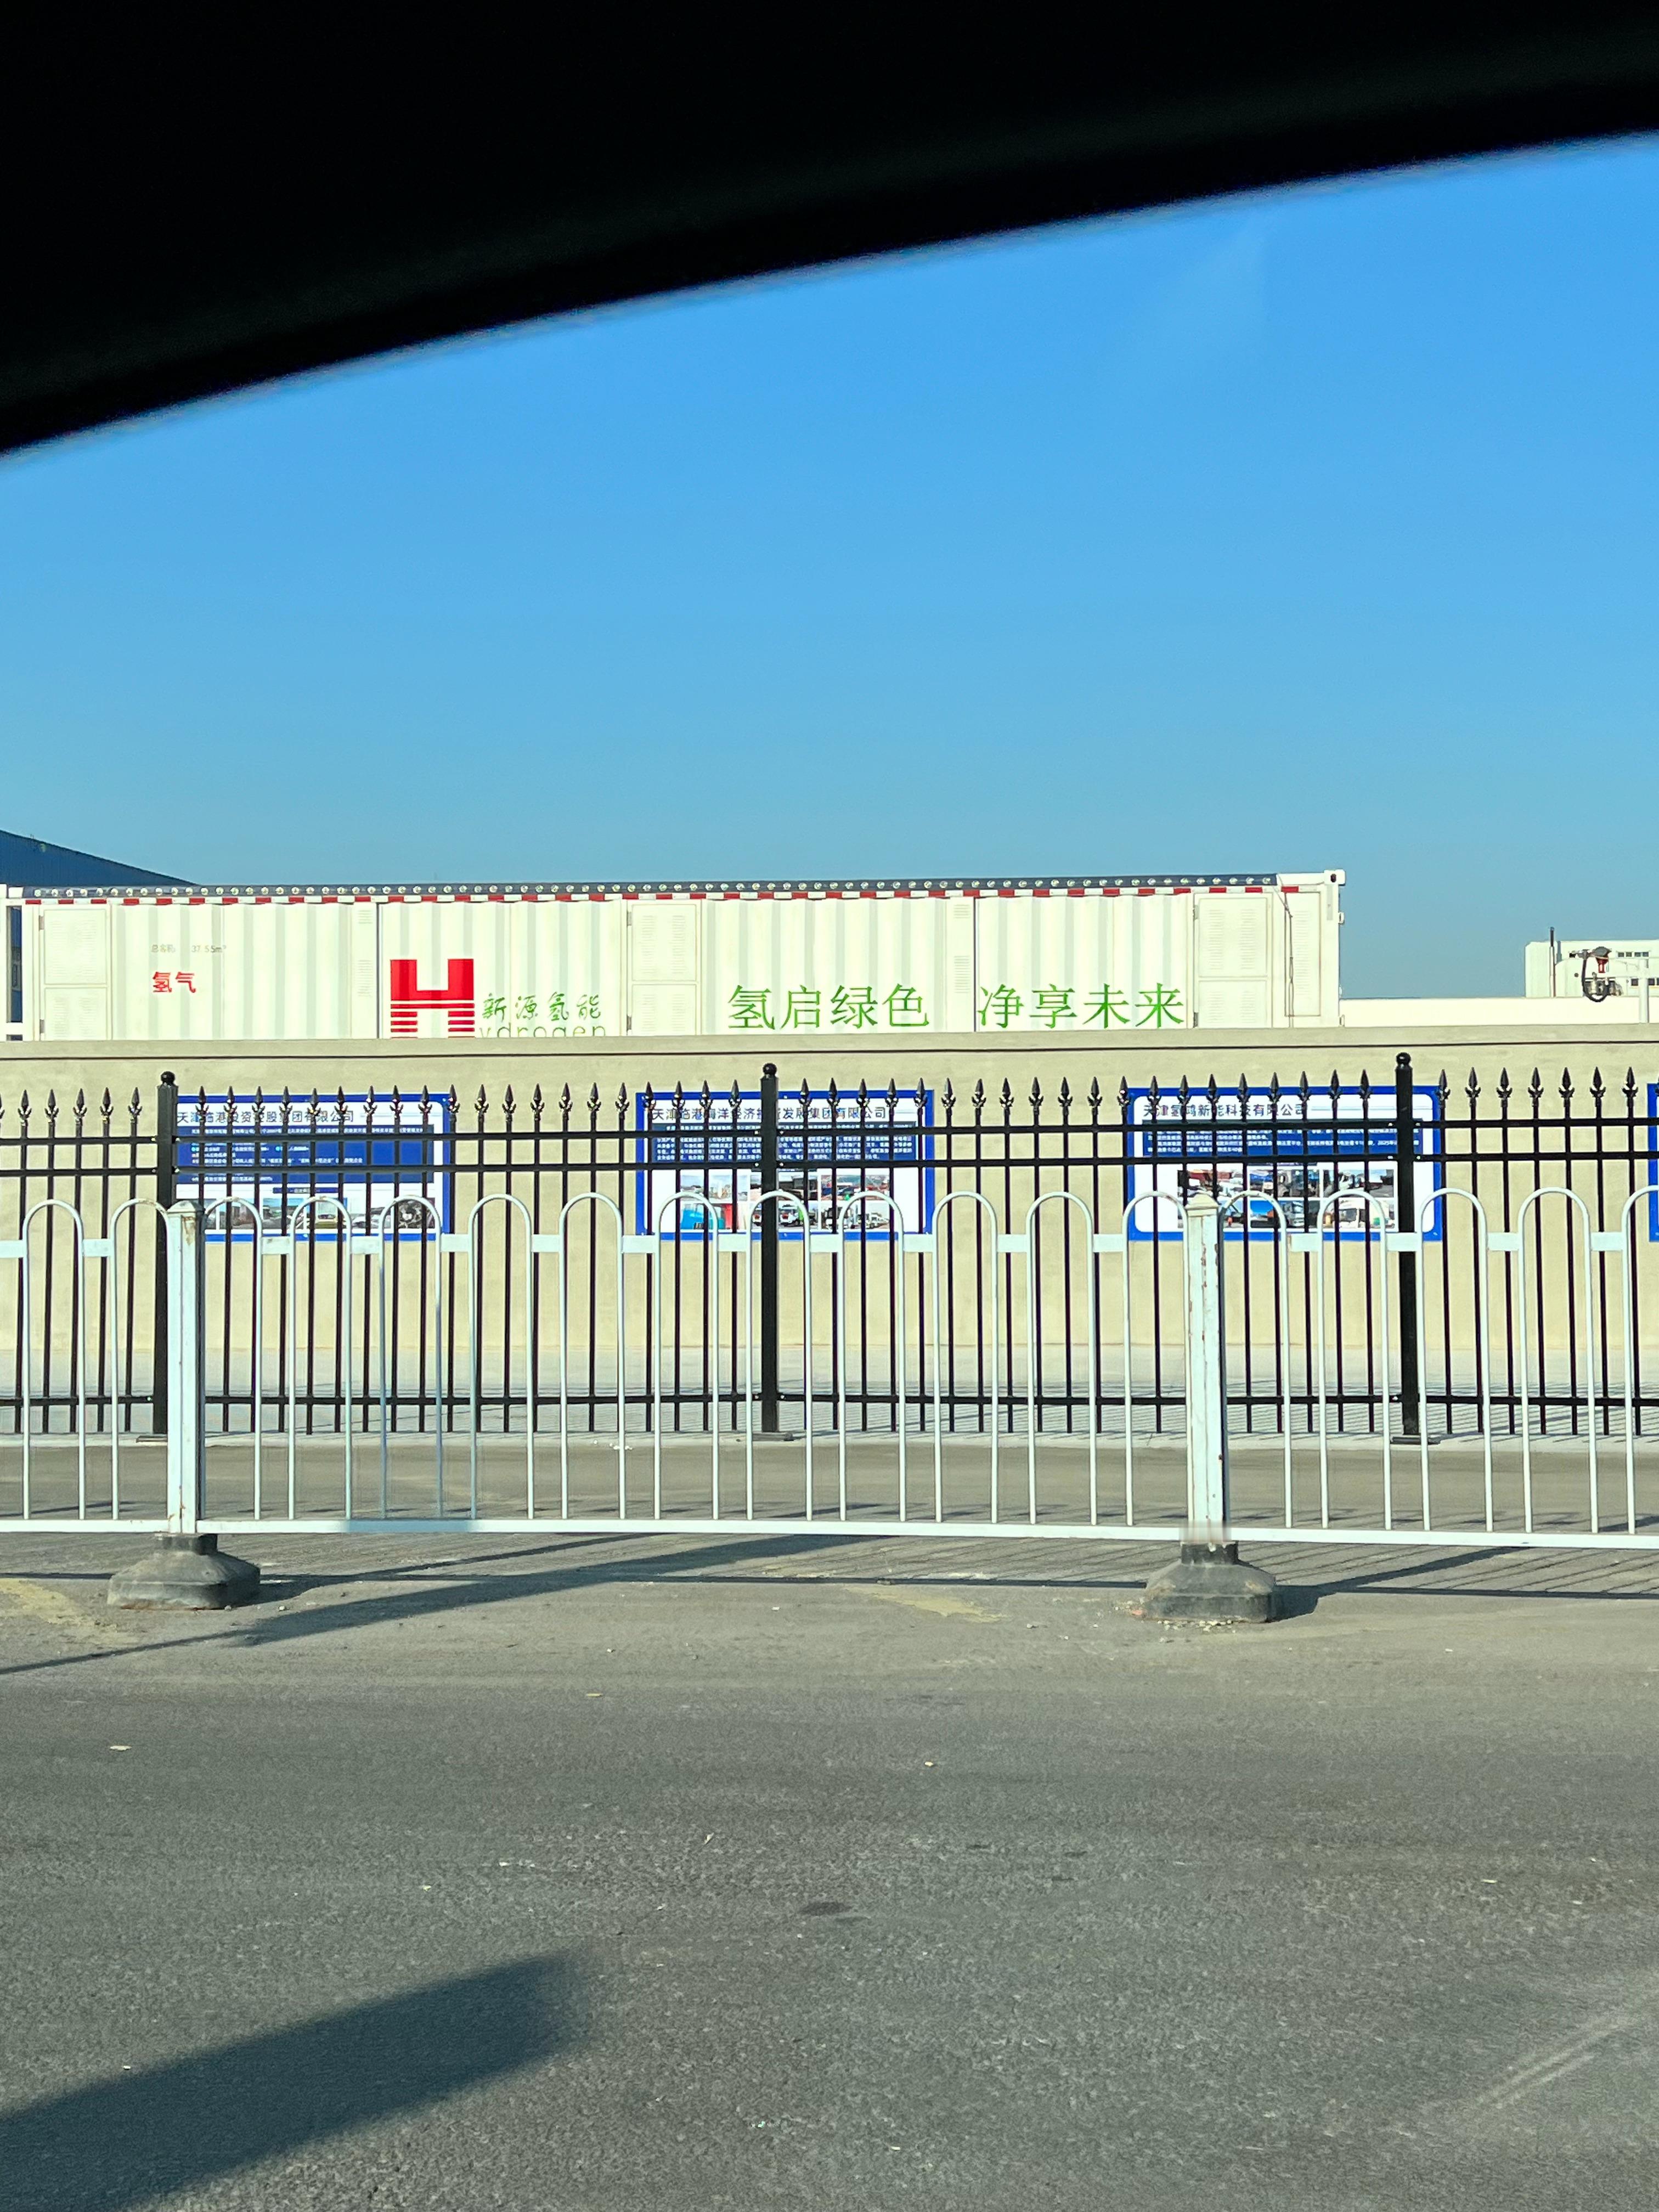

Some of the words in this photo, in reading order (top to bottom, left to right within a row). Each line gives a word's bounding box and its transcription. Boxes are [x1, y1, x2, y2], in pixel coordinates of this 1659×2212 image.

[152, 972, 196, 993] 氢气
[727, 983, 930, 1030] 氢启绿色
[977, 983, 1184, 1029] 净享未来
